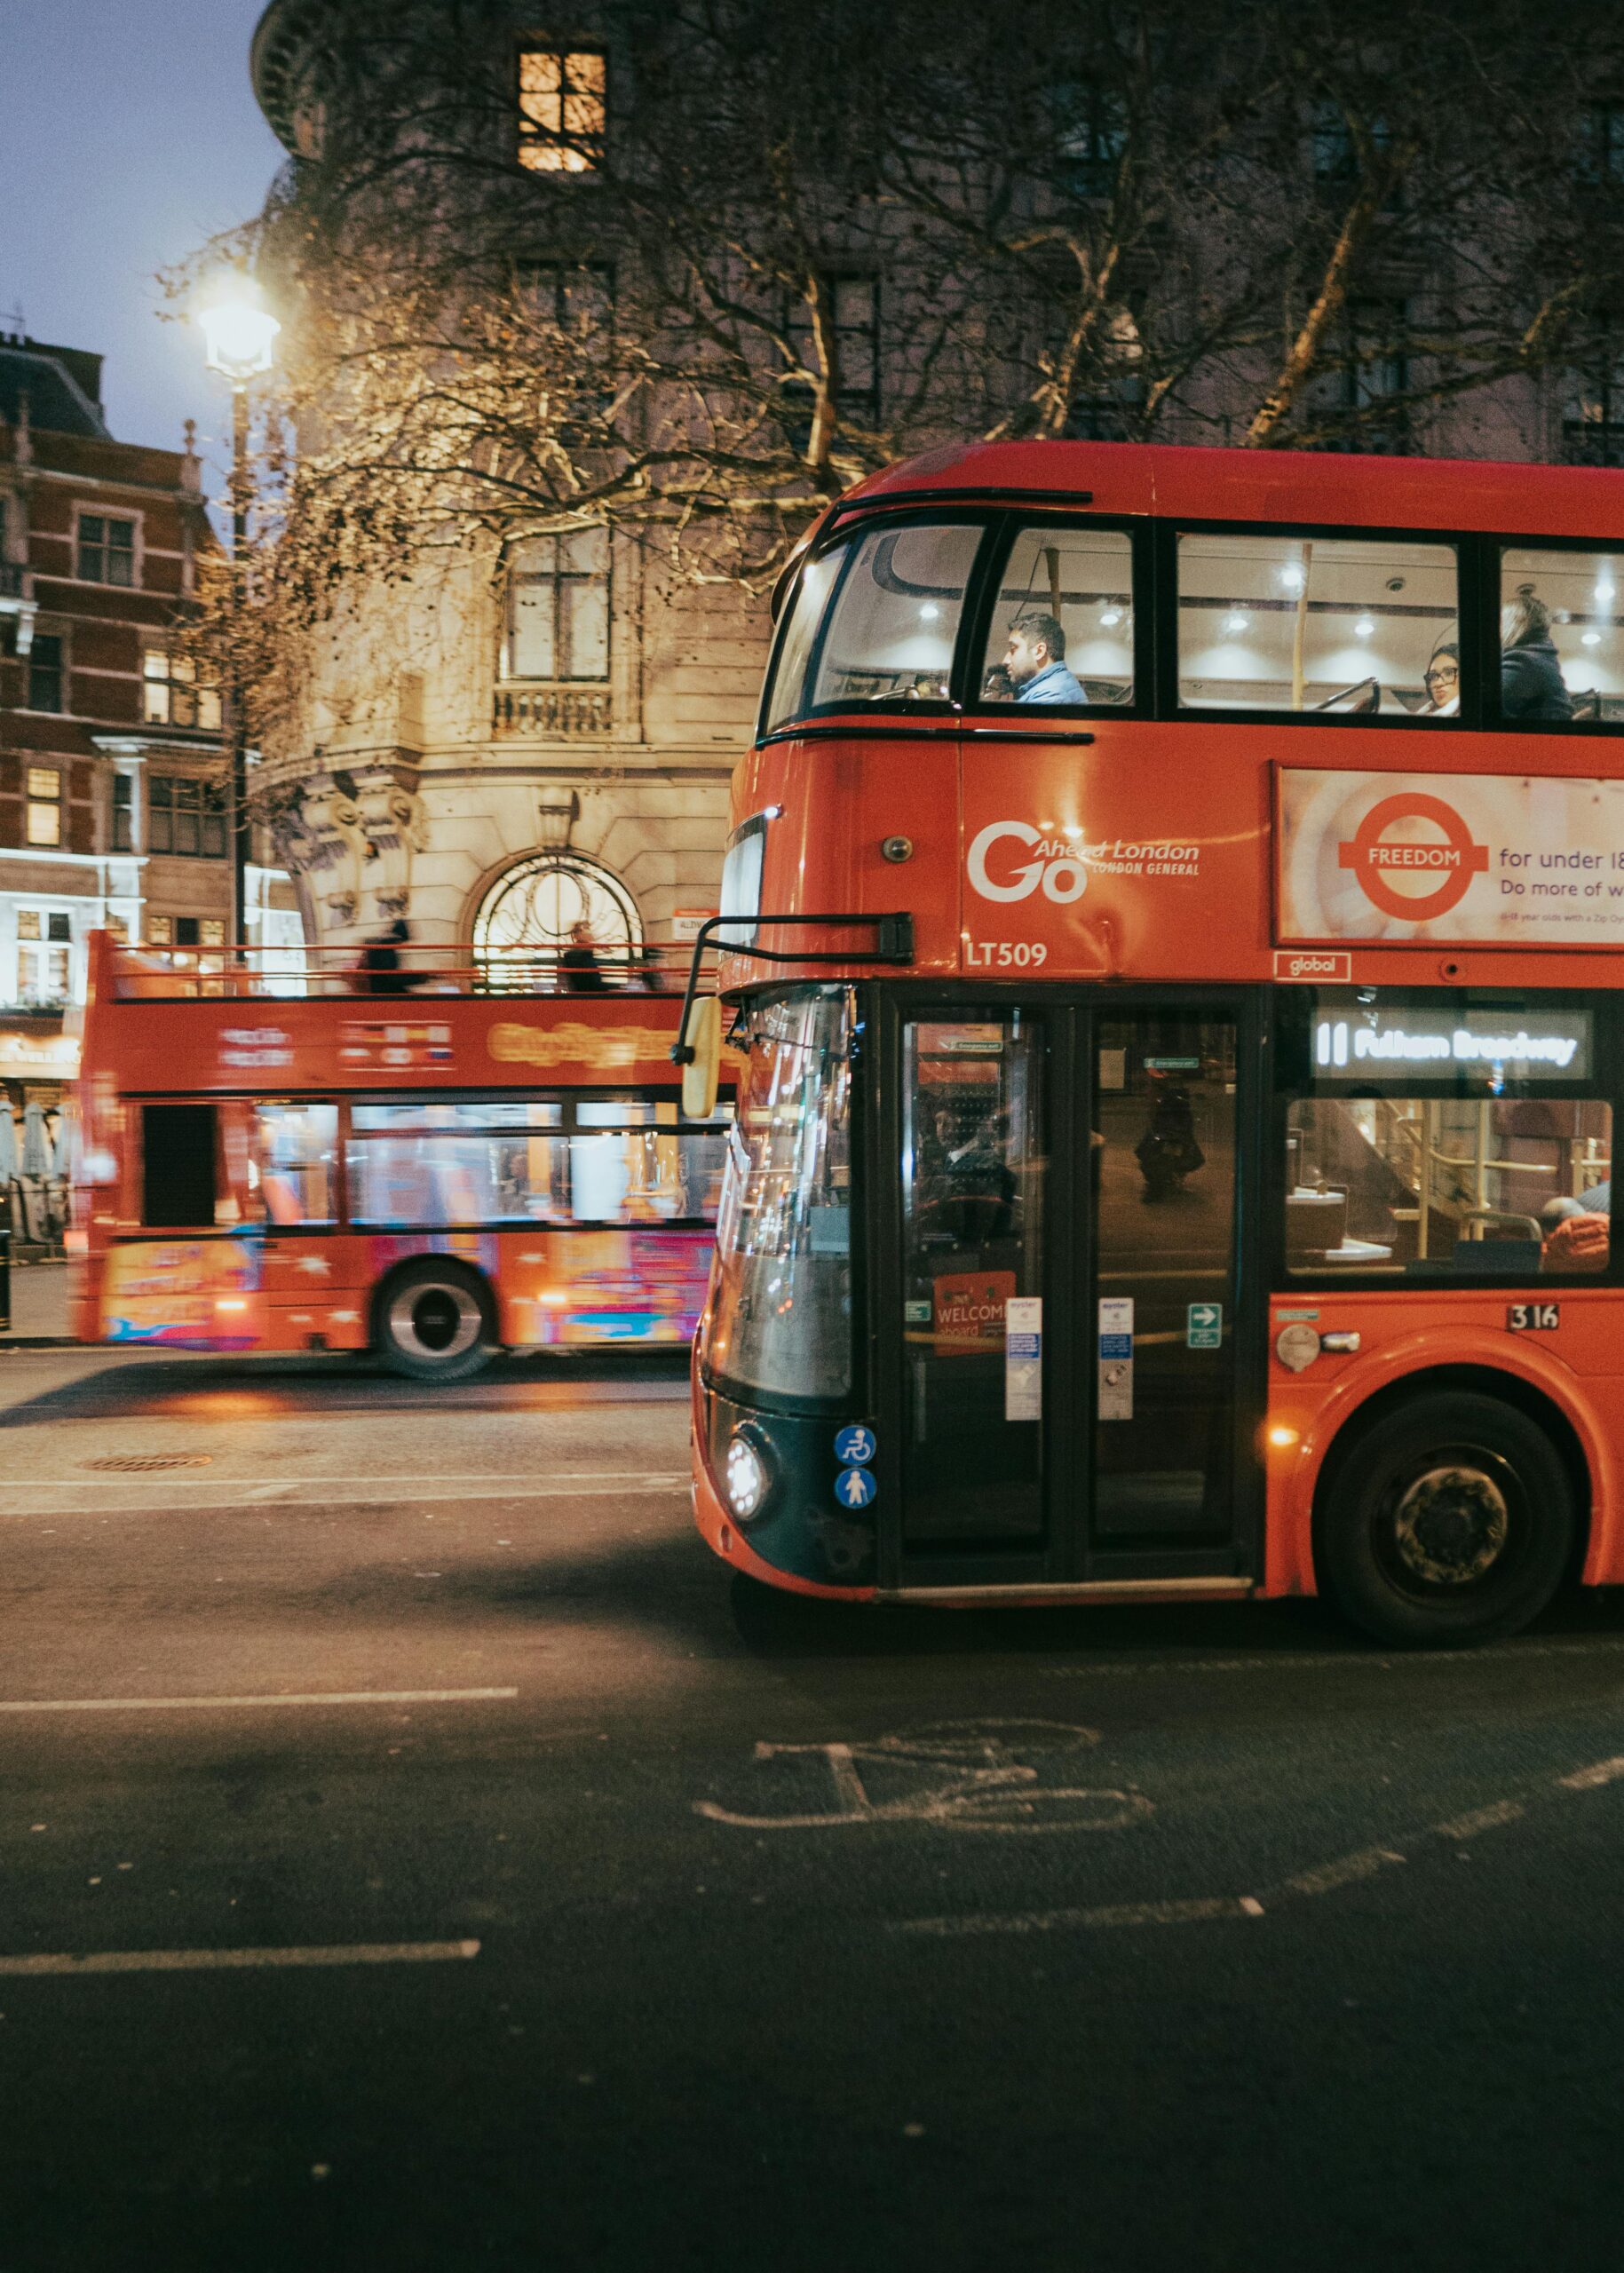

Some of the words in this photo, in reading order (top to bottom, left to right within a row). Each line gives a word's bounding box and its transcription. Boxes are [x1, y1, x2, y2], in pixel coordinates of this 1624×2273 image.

[1034, 840, 1107, 858] Ahead
[1113, 839, 1200, 860] London
[1368, 847, 1461, 867] FREEDOM
[1500, 848, 1532, 867] for
[1540, 851, 1604, 868] under
[968, 821, 1088, 904] Go
[1093, 861, 1143, 874] LONDON
[1146, 863, 1200, 875] GENERAL
[1501, 879, 1525, 895] Do
[1532, 883, 1578, 896] more
[1584, 882, 1603, 897] of
[1521, 914, 1540, 923] year
[967, 942, 1047, 966] LT509
[1290, 956, 1335, 976] global
[1317, 1022, 1348, 1065] 11
[1511, 1304, 1558, 1328] 316
